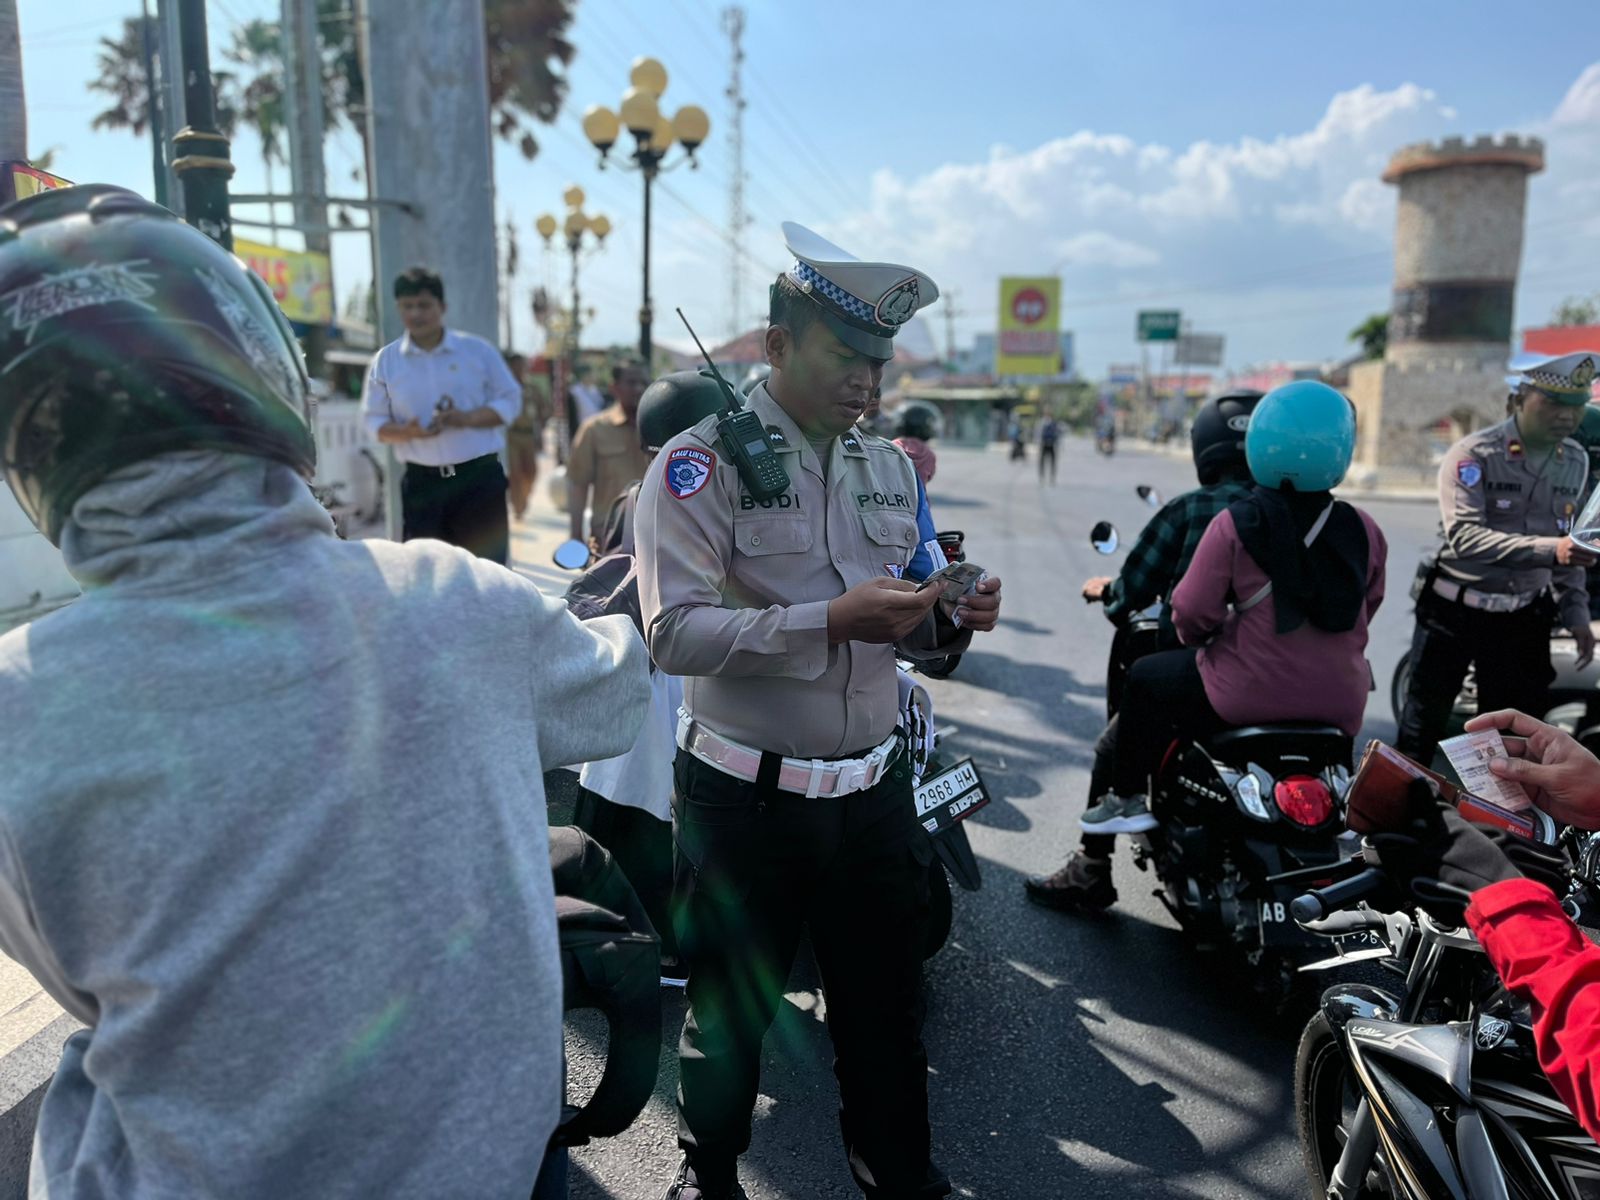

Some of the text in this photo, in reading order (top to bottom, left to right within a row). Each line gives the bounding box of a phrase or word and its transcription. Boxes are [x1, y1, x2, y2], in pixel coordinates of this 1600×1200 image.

[672, 450, 710, 463] LALU LINTAS
[857, 492, 910, 508] POLRI
[919, 768, 975, 810] 2968 HM
[1262, 902, 1286, 922] AB
